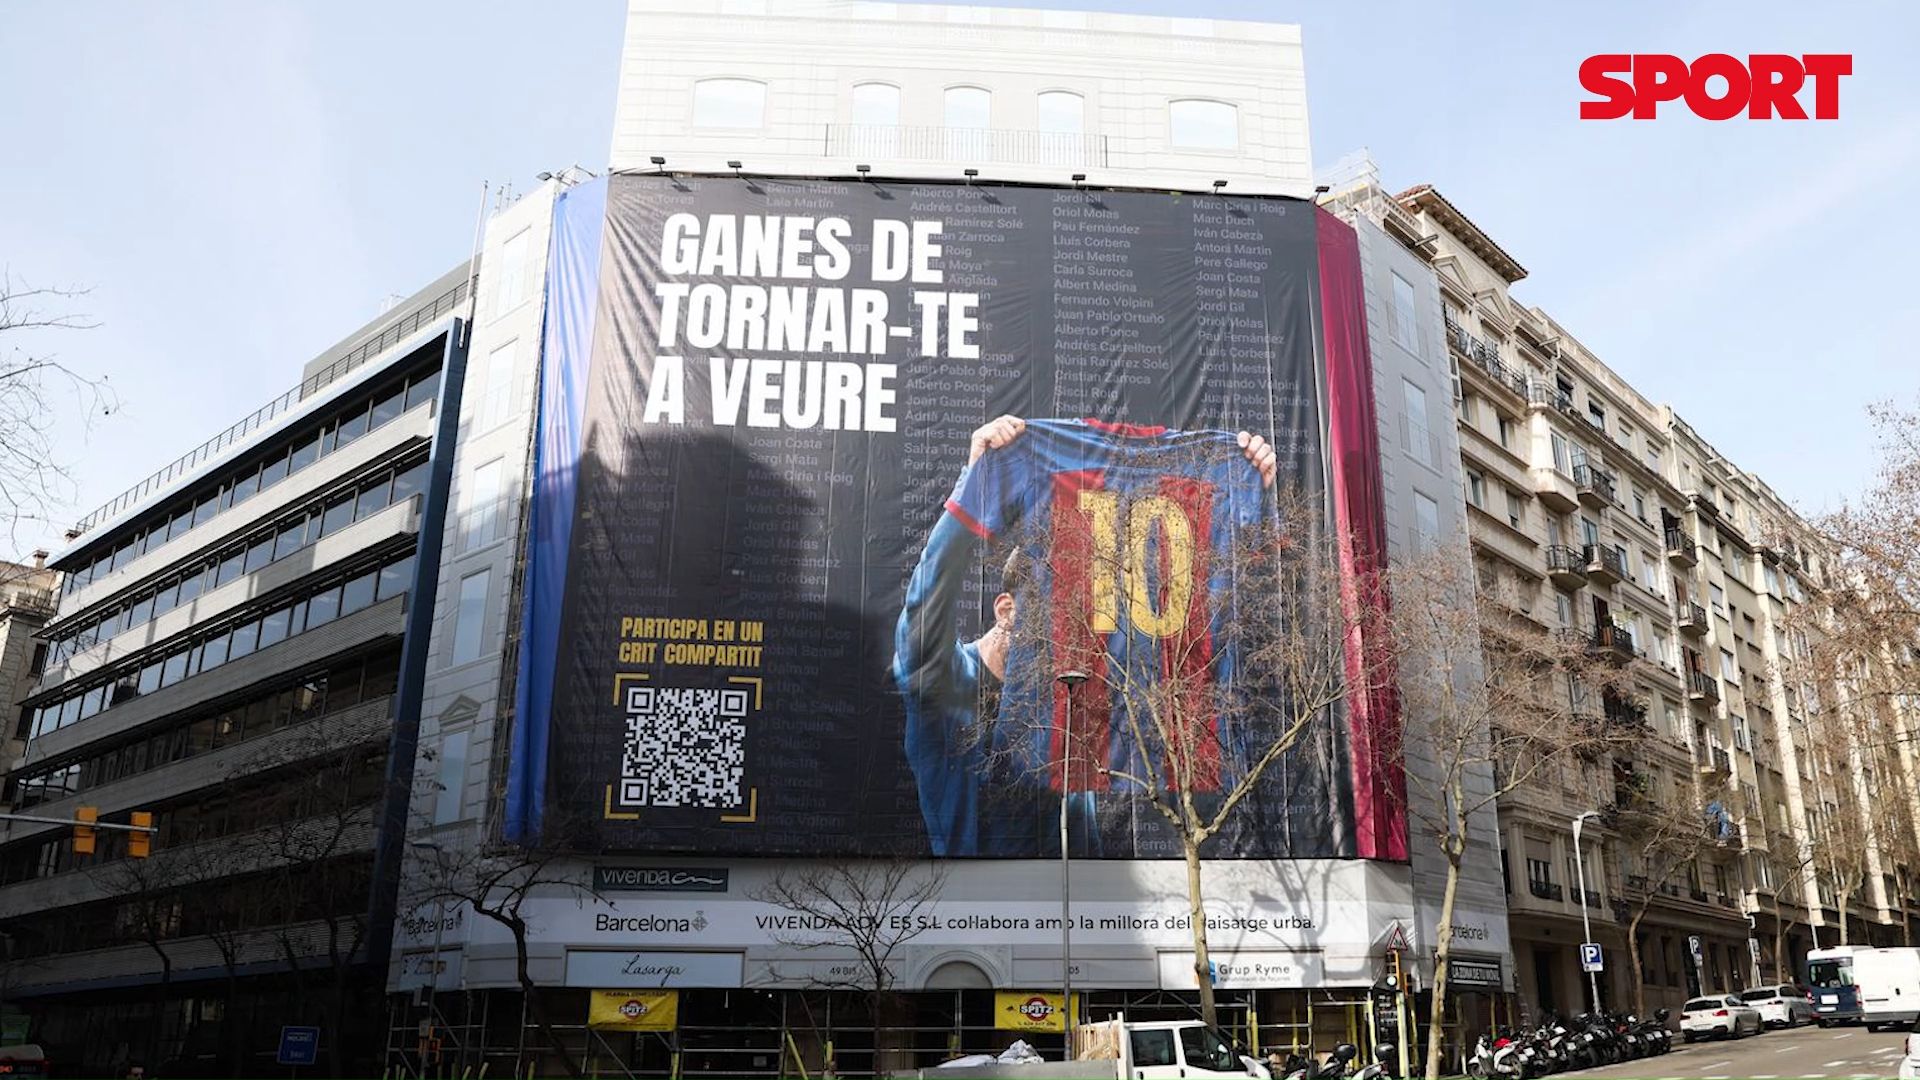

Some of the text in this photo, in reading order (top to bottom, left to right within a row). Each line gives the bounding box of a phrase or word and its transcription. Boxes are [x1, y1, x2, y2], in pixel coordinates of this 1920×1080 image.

[910, 187, 955, 199] Alberto
[1052, 191, 1083, 204] Jordi
[910, 201, 953, 214] Andrés
[1052, 206, 1120, 219] Oriol Molas
[1192, 198, 1222, 211] Marc
[1260, 203, 1287, 217] Roig
[996, 217, 1025, 230] Solé
[1193, 213, 1255, 226] Marc Duch
[1052, 220, 1141, 235] Pau Fernández
[1193, 227, 1218, 239] Iván
[958, 231, 1006, 243] Zarroca
[1052, 235, 1131, 249] Lluís Corbera
[660, 213, 944, 284] GANES DE
[945, 244, 973, 256] Roig
[1194, 241, 1231, 253] Antoni
[1053, 250, 1129, 263] Jordi Mestre
[1194, 256, 1269, 271] Pere Gallego
[948, 260, 983, 273] Moya
[1053, 264, 1134, 278] Carla Surroca
[948, 273, 999, 287] Anglada
[1053, 278, 1138, 292] Albert Medina
[1195, 271, 1262, 285] Joan Costa
[1195, 285, 1259, 298] Sergi Mata
[1054, 292, 1154, 309] Fernando Volpini
[1196, 300, 1246, 313] Jordi Gil
[655, 282, 980, 359] TORNAR-TE
[1054, 308, 1166, 324] Juan Pablo Ortuño
[1229, 317, 1265, 329] Molas
[1054, 323, 1140, 338] Alberto Ponce
[1054, 338, 1163, 354] Andrés Castelltort
[1054, 353, 1088, 366] Núria
[1142, 357, 1170, 370] Solé
[1199, 360, 1230, 372] Jordi
[939, 364, 976, 377] Pablo
[1055, 369, 1102, 382] Cristian
[904, 378, 995, 393] Alberto Ponce
[1199, 375, 1256, 388] Fernando
[643, 355, 898, 433] A VEURE
[1091, 386, 1119, 402] Roig
[1233, 392, 1268, 405] Pablo
[904, 395, 987, 409] Joan Garrido
[942, 412, 987, 425] Alonso
[749, 436, 823, 451] Joan Costa
[1077, 488, 1195, 639] 10
[620, 616, 708, 641] PARTICIPA
[712, 619, 736, 642] EN
[739, 620, 764, 643] UN
[618, 641, 658, 665] CRIT
[663, 643, 764, 668] COMPARTIT
[596, 913, 690, 932] Barcelona
[755, 915, 841, 930] VIVENDA
[890, 915, 912, 930] ES
[1079, 914, 1094, 930] la
[1099, 914, 1159, 930] millora
[1164, 915, 1191, 930] del
[1204, 916, 1268, 933] aisatge
[1273, 914, 1317, 931] urbà.
[1449, 923, 1484, 941] arcelona
[1692, 938, 1699, 953] P
[1585, 946, 1598, 963] P
[1219, 963, 1291, 978] Grup Ryme
[1020, 1004, 1054, 1014] SPITZ
